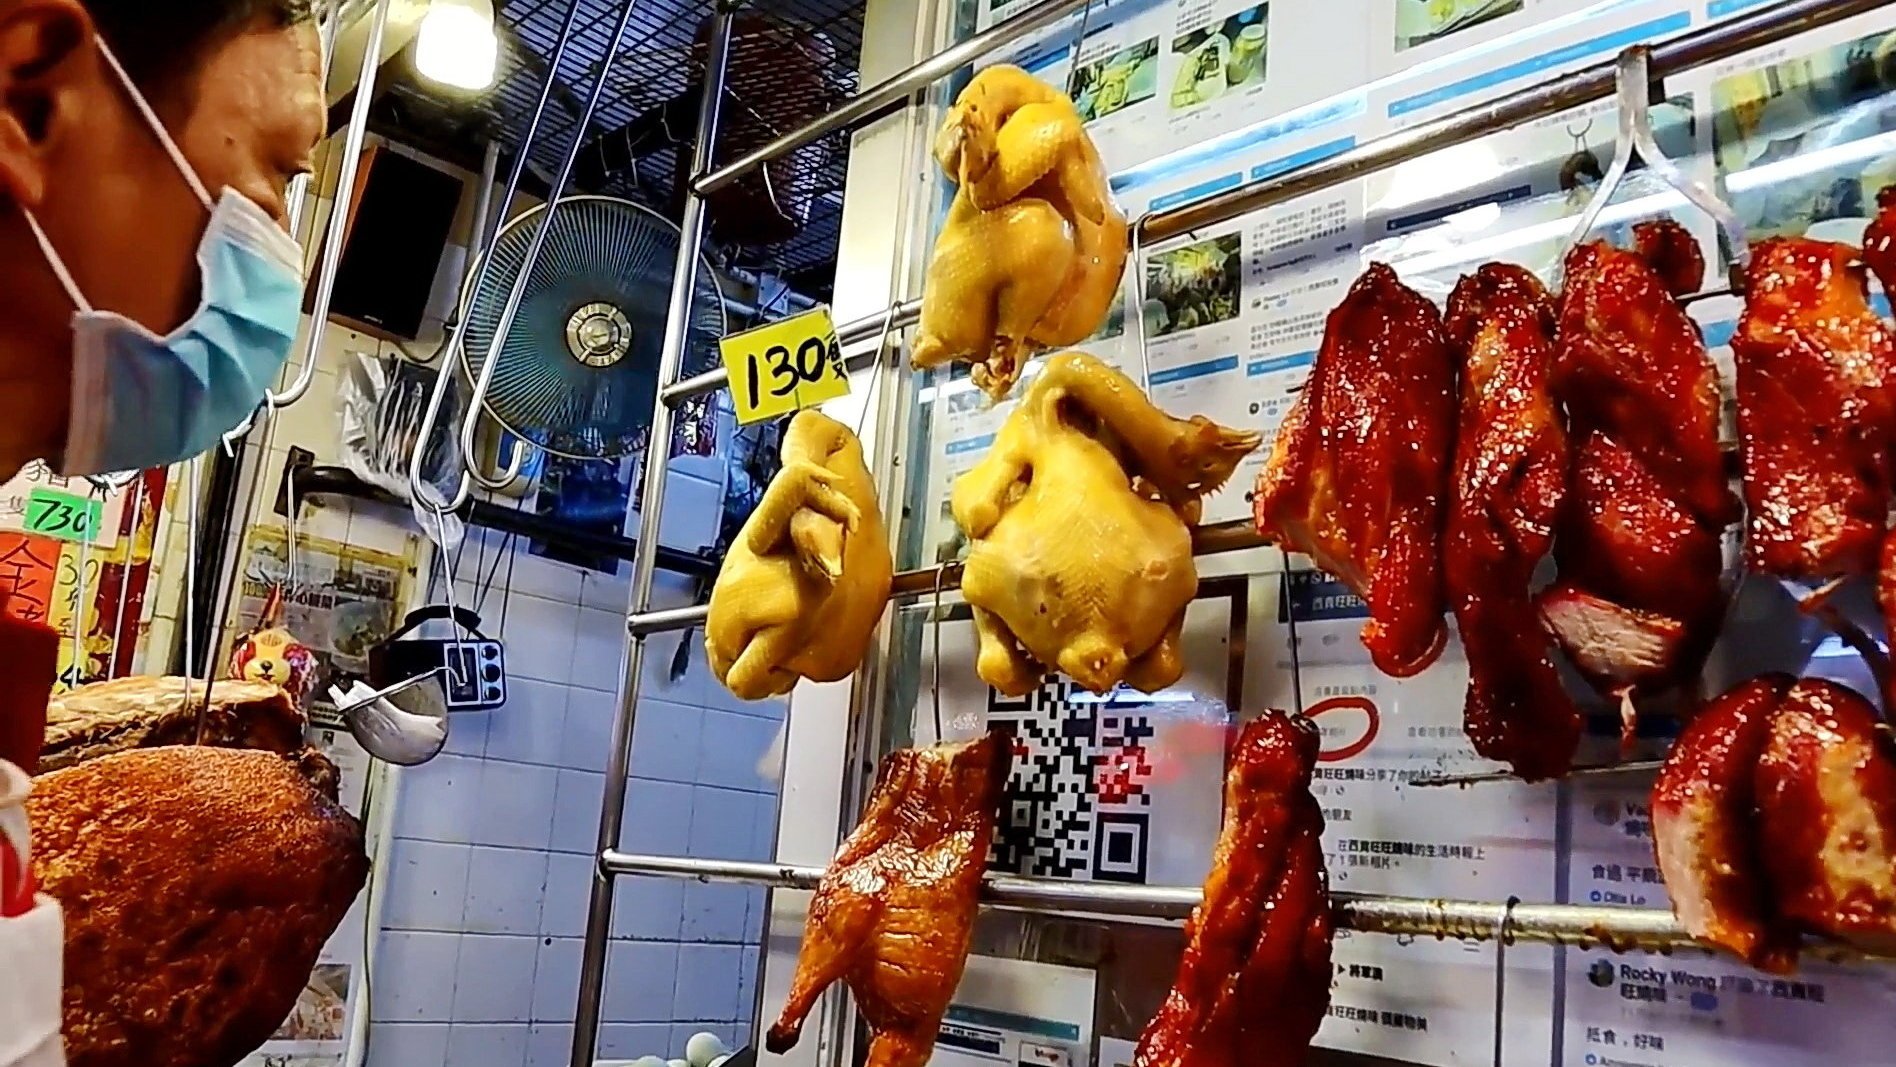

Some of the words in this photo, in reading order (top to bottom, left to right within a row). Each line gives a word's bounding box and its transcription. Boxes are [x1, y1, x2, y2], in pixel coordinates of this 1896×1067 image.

[748, 337, 826, 410] 130
[33, 498, 92, 532] 730
[1620, 964, 1667, 985] Rocky
[1670, 970, 1716, 990] Wong
